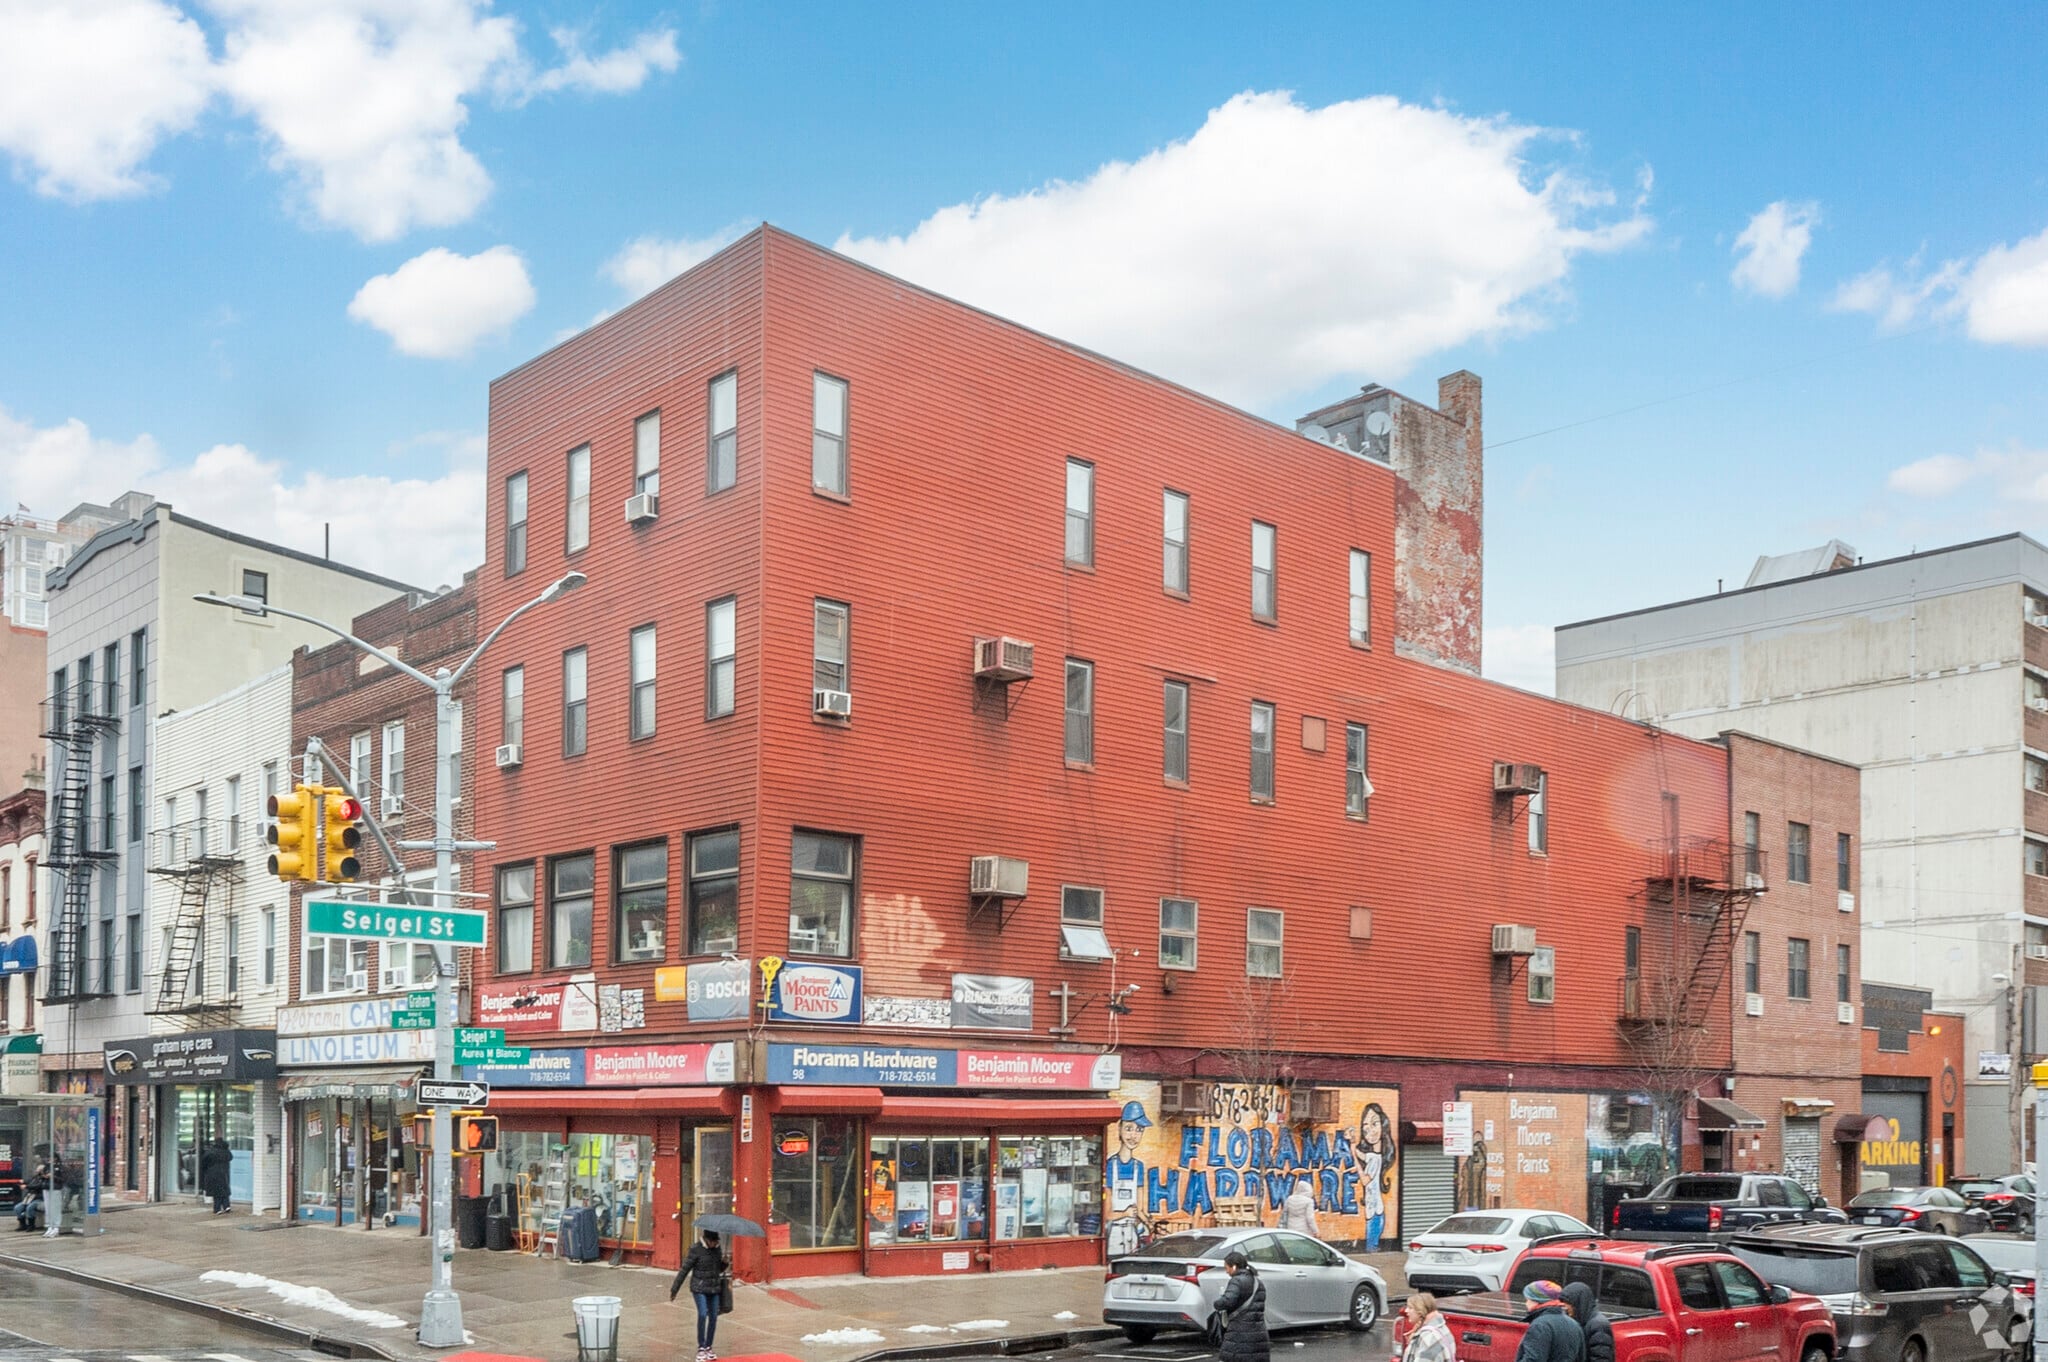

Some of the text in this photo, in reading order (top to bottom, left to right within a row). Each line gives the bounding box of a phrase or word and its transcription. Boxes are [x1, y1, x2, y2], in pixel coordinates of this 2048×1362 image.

[342, 910, 455, 937] Seigel St
[705, 980, 750, 999] BOSCH
[784, 979, 830, 996] Moore
[481, 992, 525, 1013] Benjam
[793, 999, 839, 1013] PAINTS
[398, 1016, 431, 1027] Puerto Rico
[152, 1037, 213, 1057] graham eye care
[290, 1034, 399, 1062] LINOLEUM
[460, 1031, 488, 1047] Seigel
[461, 1048, 522, 1059] Aurea M Blanco
[594, 1052, 686, 1075] Benjamin Moore
[793, 1048, 937, 1069] Florama Hardware
[792, 1069, 936, 1082] 98 718-782-6514
[967, 1055, 1072, 1076] Benjamin Moore
[968, 1074, 981, 1083] The
[982, 1074, 1005, 1083] Leader
[1014, 1075, 1031, 1083] Paint
[1038, 1075, 1056, 1084] Color
[424, 1088, 479, 1099] ONE WAY
[1510, 1099, 1557, 1122] Benjamin
[1517, 1126, 1552, 1145] Moore
[1178, 1125, 1355, 1169] FLORAMA
[1860, 1141, 1920, 1166] ARKING
[1516, 1152, 1550, 1173] Paints
[1146, 1166, 1359, 1216] HARDWRE
